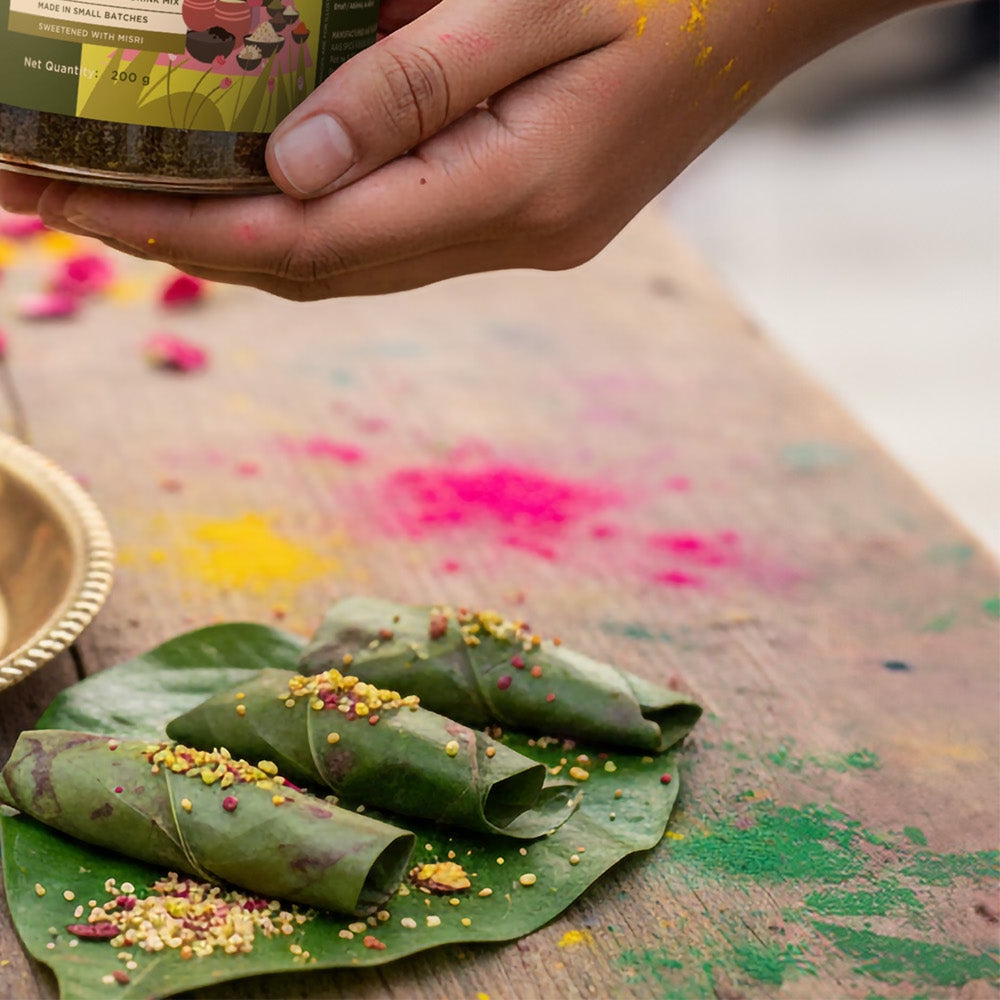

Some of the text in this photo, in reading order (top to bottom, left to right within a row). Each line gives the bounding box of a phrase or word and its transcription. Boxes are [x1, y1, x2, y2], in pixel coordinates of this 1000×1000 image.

[38, 1, 149, 24] MADE IN SMALL BATCHES
[38, 22, 144, 44] SWEETENED WITH MISRI
[24, 56, 42, 70] Net
[111, 70, 137, 82] 200
[142, 75, 150, 86] g
